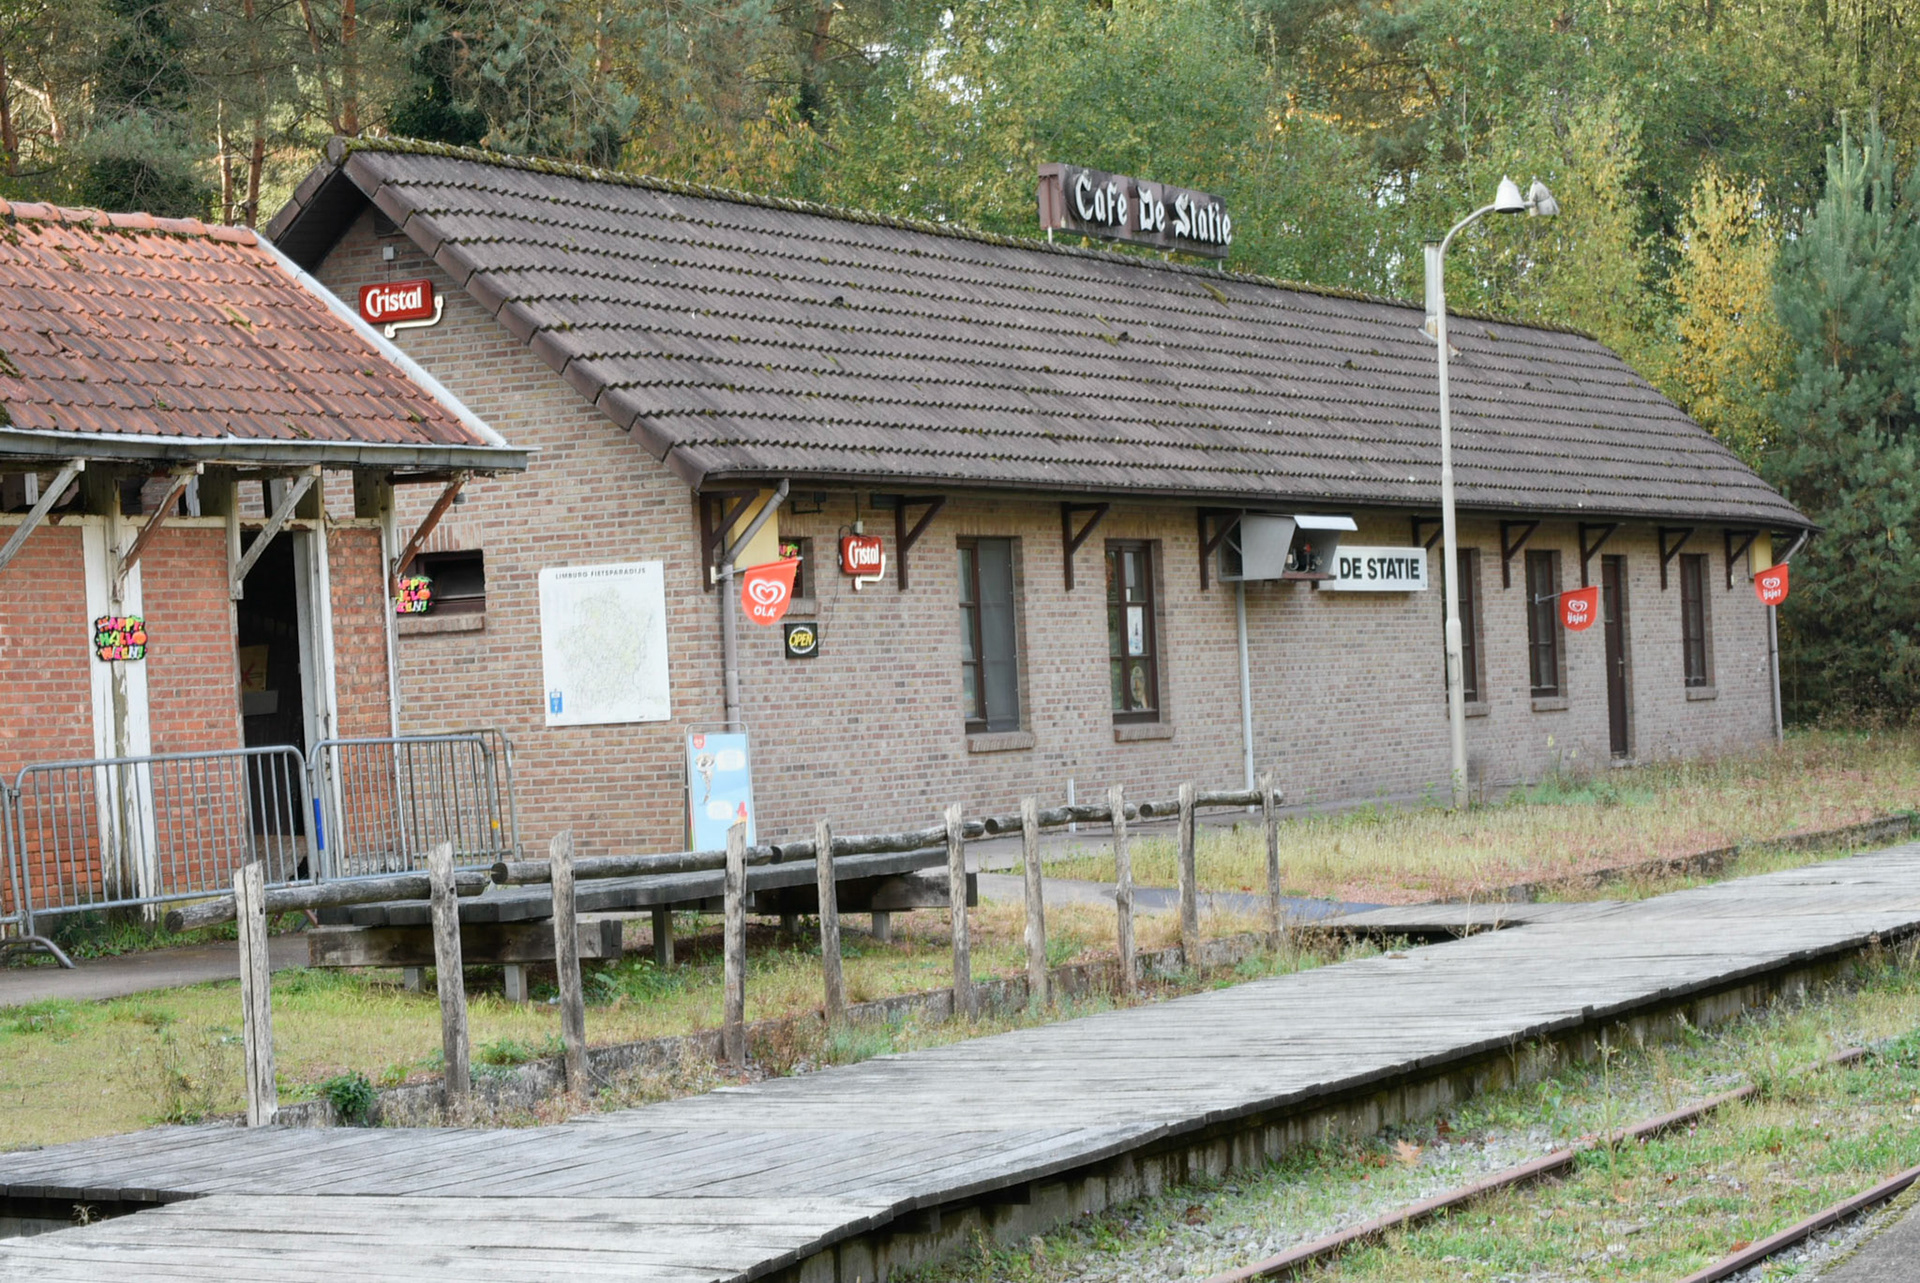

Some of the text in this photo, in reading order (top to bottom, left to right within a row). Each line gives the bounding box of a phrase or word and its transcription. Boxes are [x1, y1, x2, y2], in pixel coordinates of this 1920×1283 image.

[1138, 186, 1165, 232] De
[1173, 193, 1232, 245] Statie
[365, 286, 423, 318] Cristal
[848, 541, 879, 569] Cristal
[555, 572, 589, 580] LIMBURG
[1340, 557, 1420, 580] DE STATIE
[753, 606, 775, 617] OLA
[789, 634, 813, 647] OPEN
